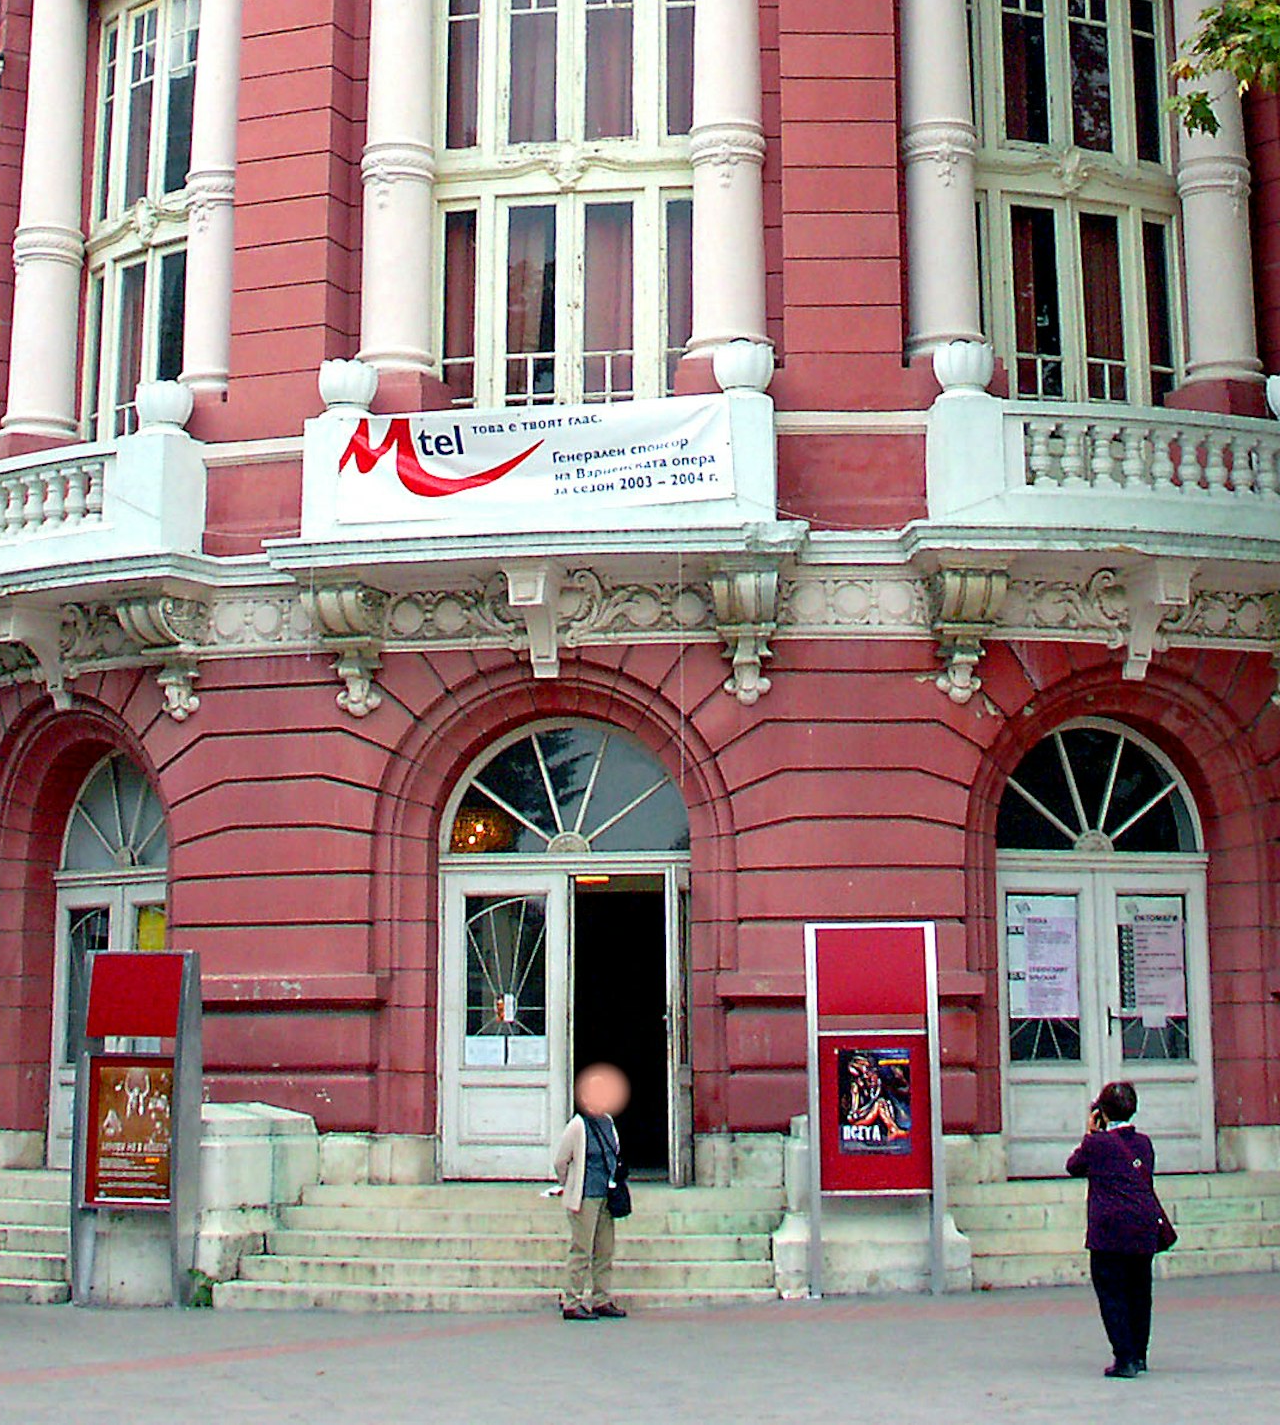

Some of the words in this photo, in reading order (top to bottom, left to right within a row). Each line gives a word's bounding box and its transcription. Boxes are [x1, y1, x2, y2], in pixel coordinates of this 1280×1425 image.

[552, 448, 627, 465] Генерален
[630, 438, 690, 457] спонсор
[554, 471, 571, 482] на
[671, 454, 716, 468] опера
[572, 482, 615, 495] сезон
[619, 475, 653, 492] 2003
[671, 471, 704, 488] 2004
